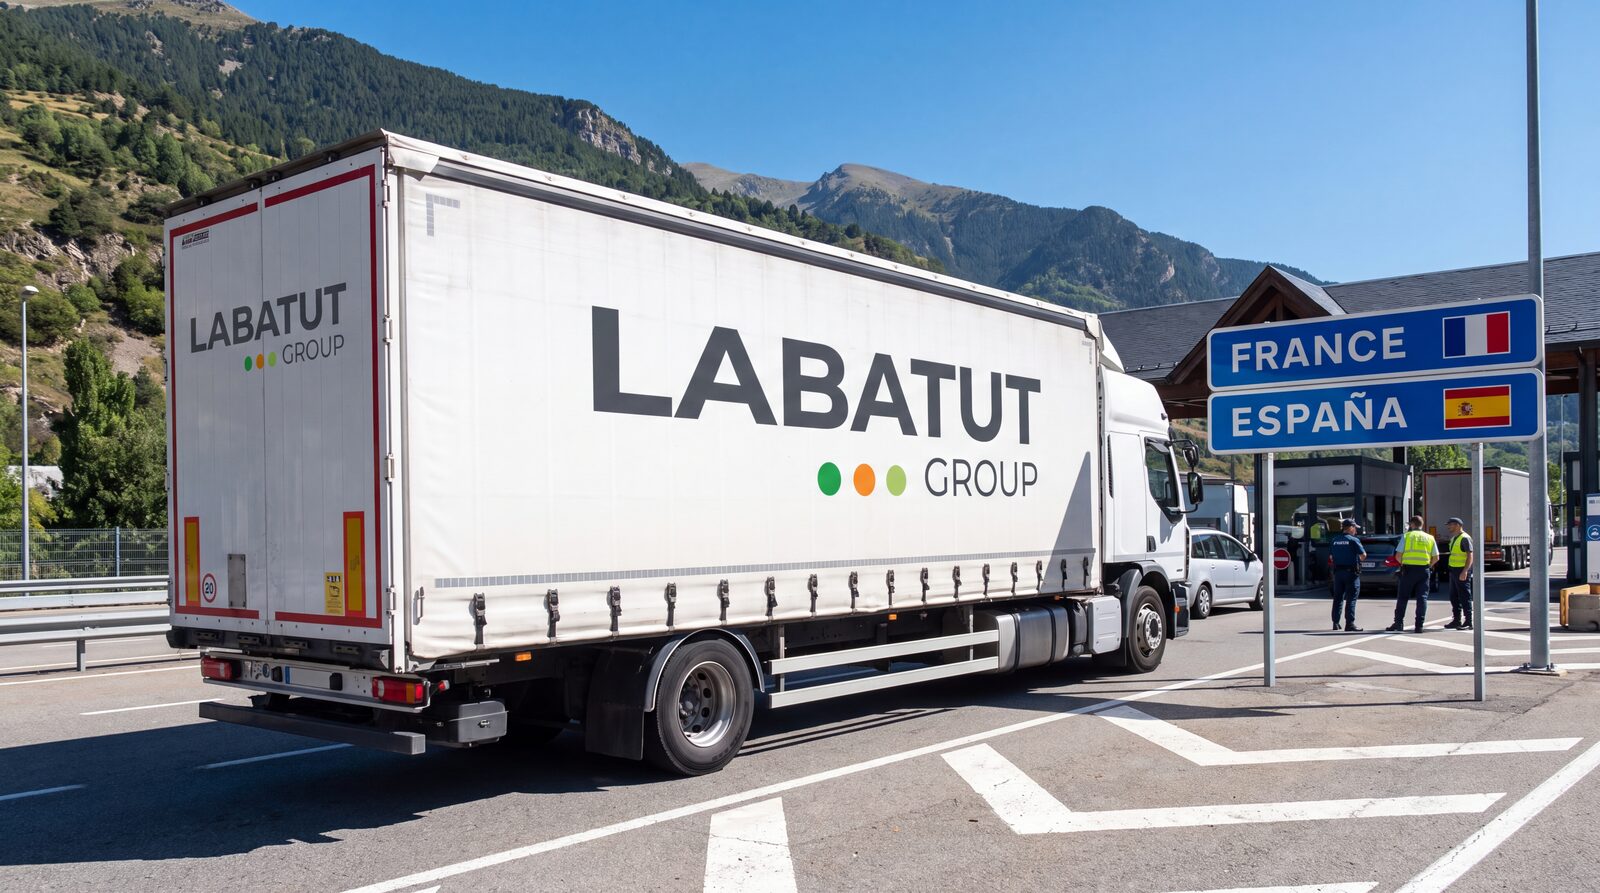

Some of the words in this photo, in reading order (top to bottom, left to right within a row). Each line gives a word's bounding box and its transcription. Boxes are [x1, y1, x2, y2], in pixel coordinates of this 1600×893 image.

[191, 282, 347, 353] LABATUT
[282, 334, 345, 365] GROUP
[1232, 327, 1406, 373] FRANCE
[592, 305, 1041, 445] LABATUT
[1232, 391, 1408, 437] ESPAÑA
[924, 457, 1038, 498] GROUP
[205, 582, 214, 594] 20
